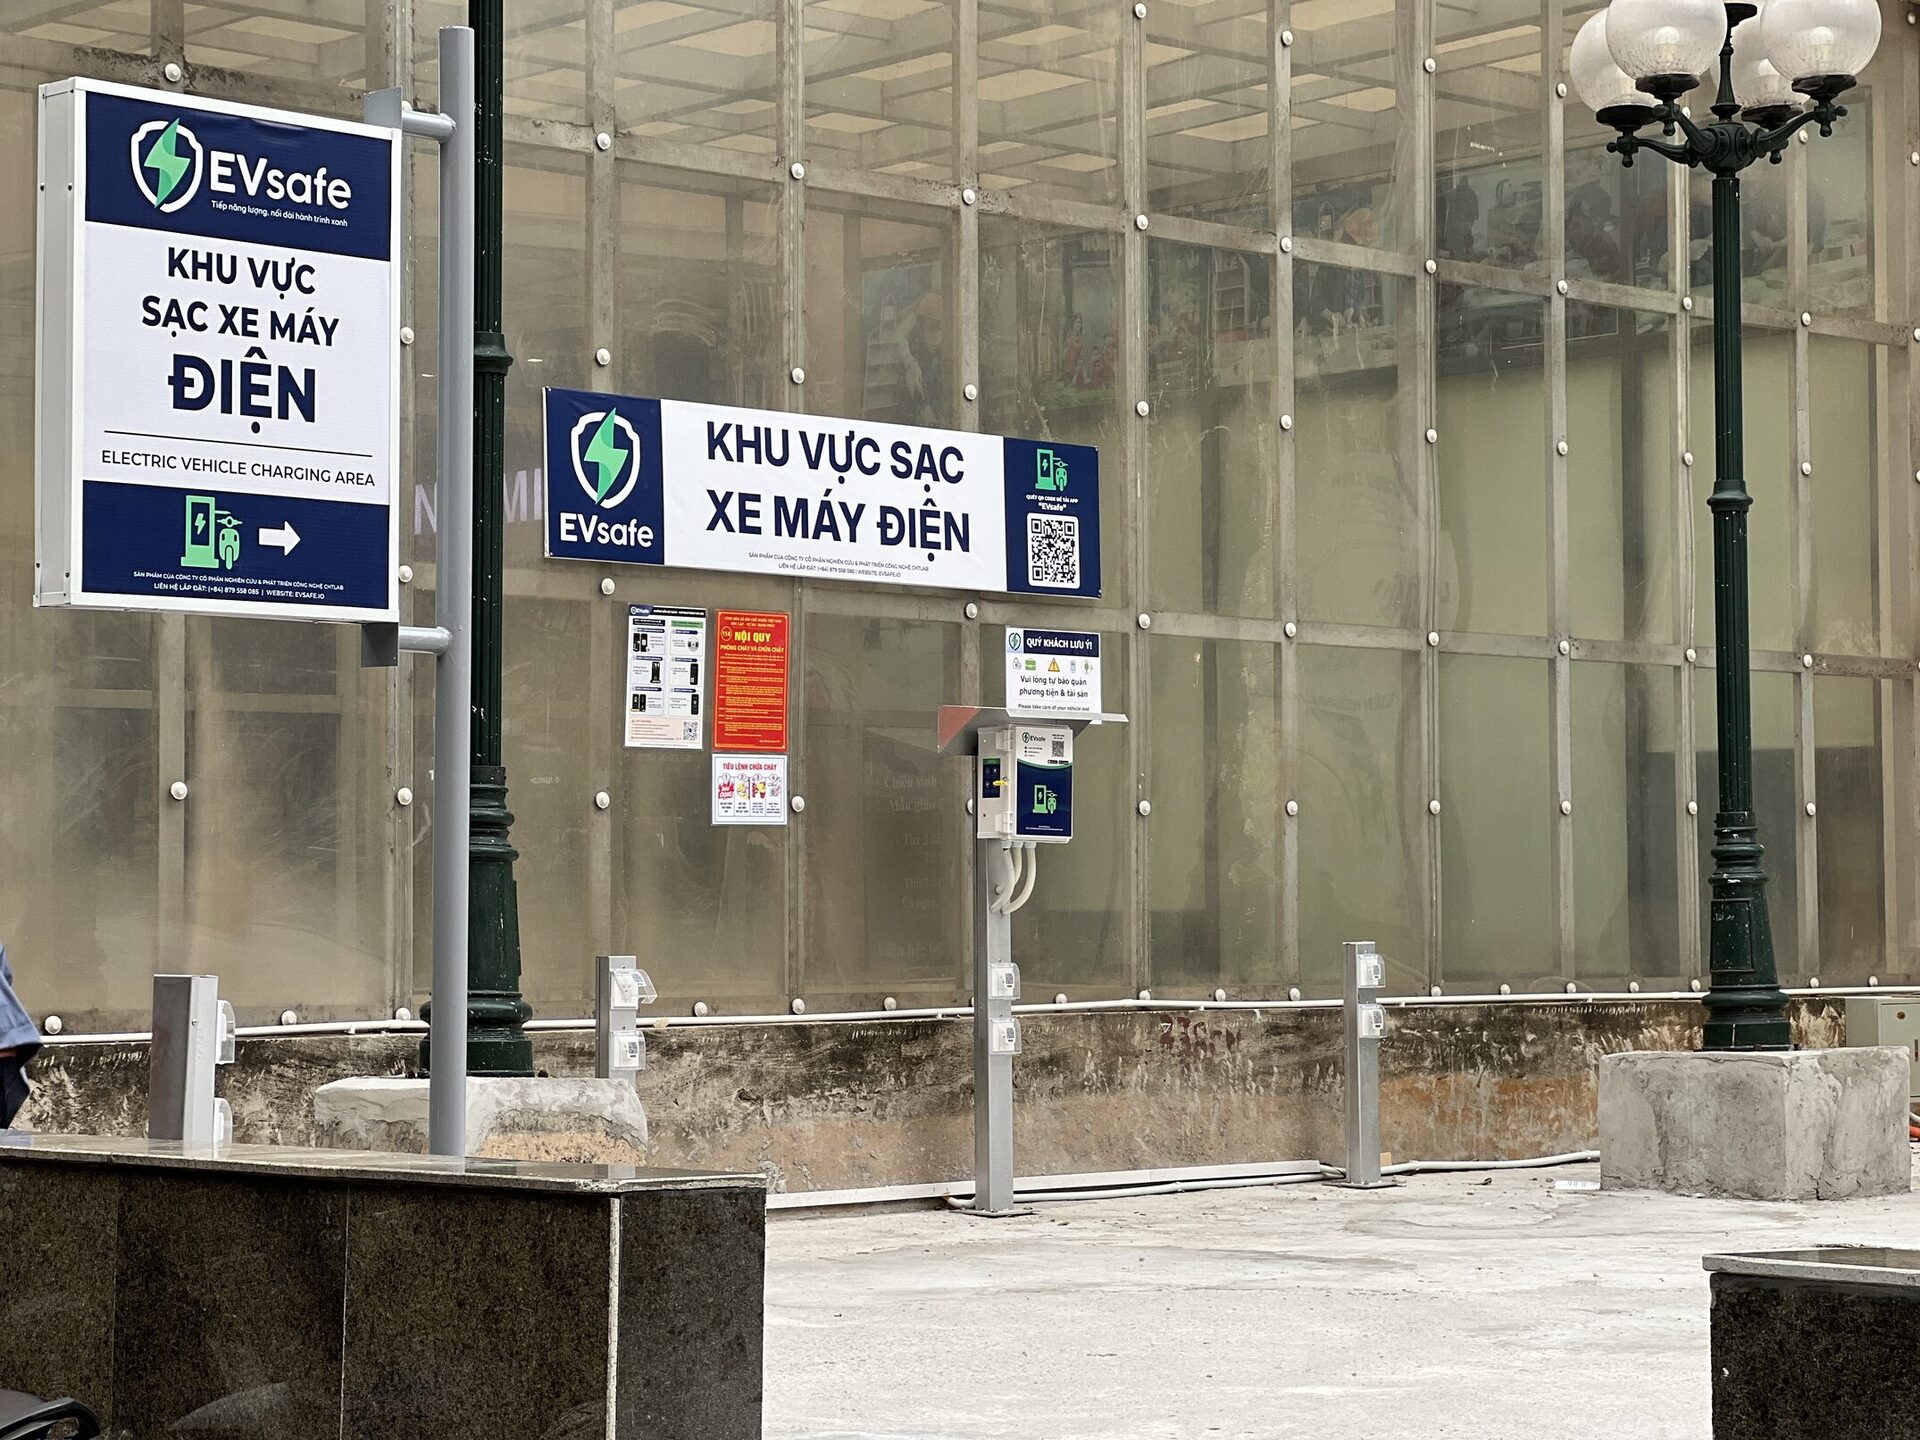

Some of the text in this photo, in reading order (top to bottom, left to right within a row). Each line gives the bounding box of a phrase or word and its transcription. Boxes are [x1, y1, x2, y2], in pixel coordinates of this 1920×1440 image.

[210, 150, 352, 209] EVsafe
[211, 200, 348, 227] Tiếp năng lượng, nối dài hành trình xanh
[168, 246, 316, 300] KHU VỰC
[142, 296, 340, 346] SẠC XE MÁY
[168, 346, 316, 434] ĐIỆN
[102, 450, 376, 486] ELECTRIC VEHICLE CHARGING AREA
[707, 420, 964, 492] KHU VỰC SẠC
[560, 512, 654, 549] EVsafe
[706, 488, 970, 562] XE MÁY ĐIỆN
[735, 630, 771, 643] NỘI QUY
[1026, 636, 1093, 650] QUÝ KHÁCH LƯU Ý!
